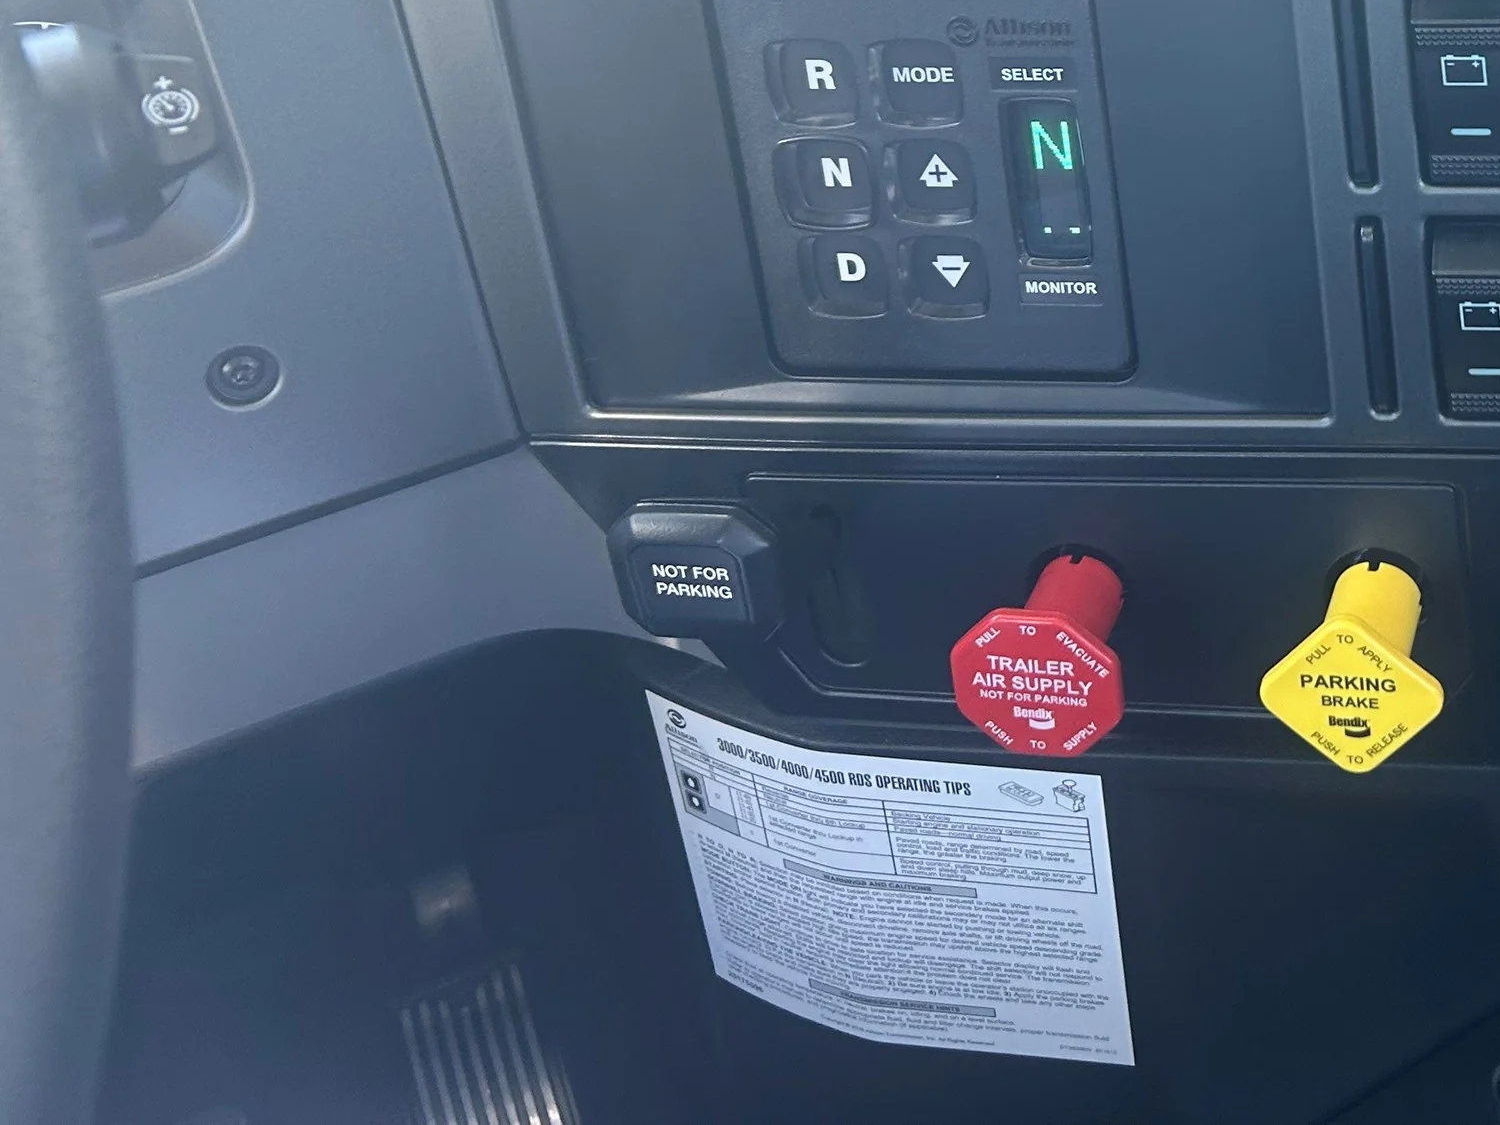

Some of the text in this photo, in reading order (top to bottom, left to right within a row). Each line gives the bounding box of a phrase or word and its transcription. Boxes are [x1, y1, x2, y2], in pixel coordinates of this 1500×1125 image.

[804, 59, 836, 90] R
[892, 66, 955, 83] MODE
[1001, 68, 1064, 81] SELECT
[1030, 120, 1073, 170] N
[821, 157, 852, 188] N
[836, 252, 866, 282] D
[1025, 281, 1098, 295] MONITOR
[652, 564, 730, 581] NOT FOR
[656, 582, 733, 599] PARKING
[975, 625, 1110, 679] PULL TO EVACUATE
[1305, 634, 1394, 673] PULL TO APPLY
[986, 655, 1074, 676] TRAILER
[972, 672, 1092, 696] AIR SUPPLY
[1300, 674, 1396, 693] PARKING
[980, 689, 1087, 707] NOT FOR PARKING
[1321, 695, 1379, 710] BRAKE
[1013, 706, 1053, 720] Bendix
[1328, 715, 1368, 728] Bendix
[985, 720, 1098, 751] PUSH TO SUPPLY
[1310, 723, 1408, 764] PUSH TO RELEASE
[717, 737, 845, 785] 3000/3500/4000/4500
[848, 773, 873, 788] RDS
[875, 775, 941, 794] OPERATING
[943, 781, 971, 796] TIPS
